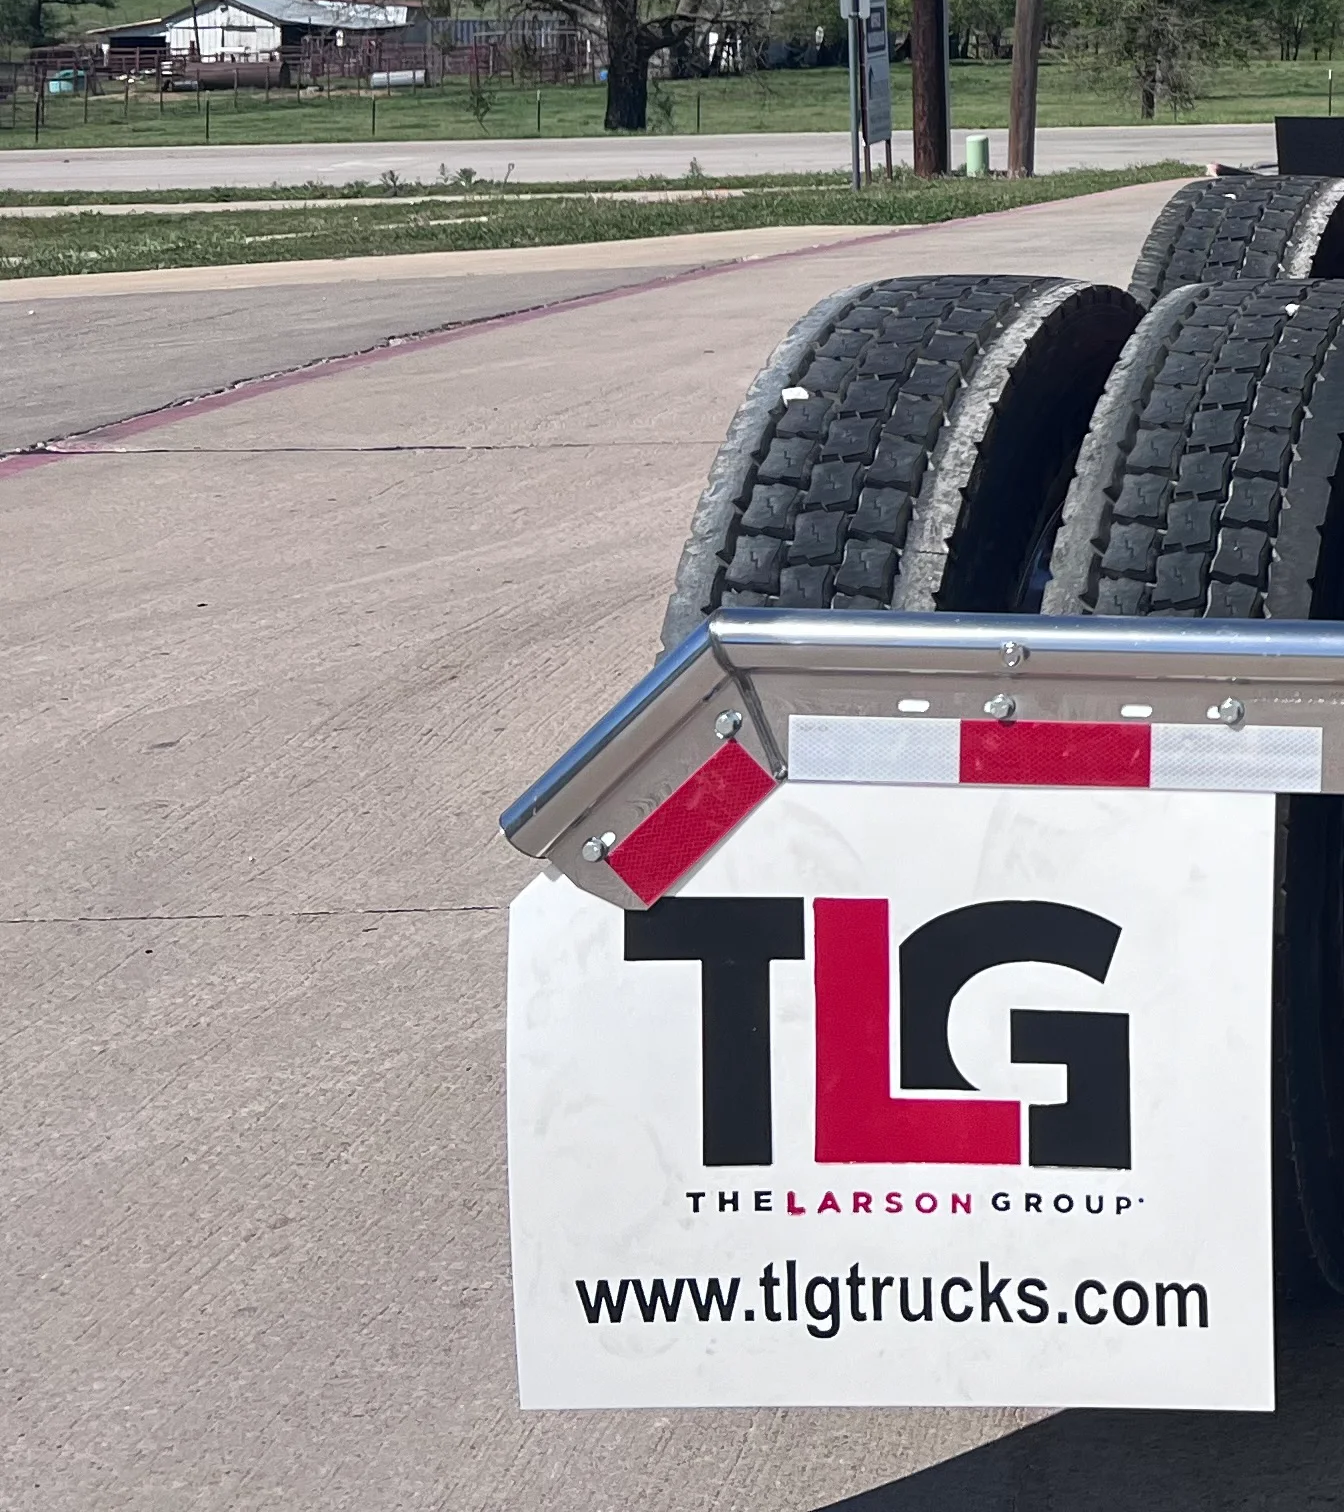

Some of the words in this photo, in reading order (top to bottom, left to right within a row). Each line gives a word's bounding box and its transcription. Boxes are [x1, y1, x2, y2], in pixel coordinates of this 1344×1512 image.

[623, 897, 1132, 1171] TLG
[991, 1192, 1132, 1215] GROUP
[575, 1259, 1209, 1339] www.tlgtrucks.com
